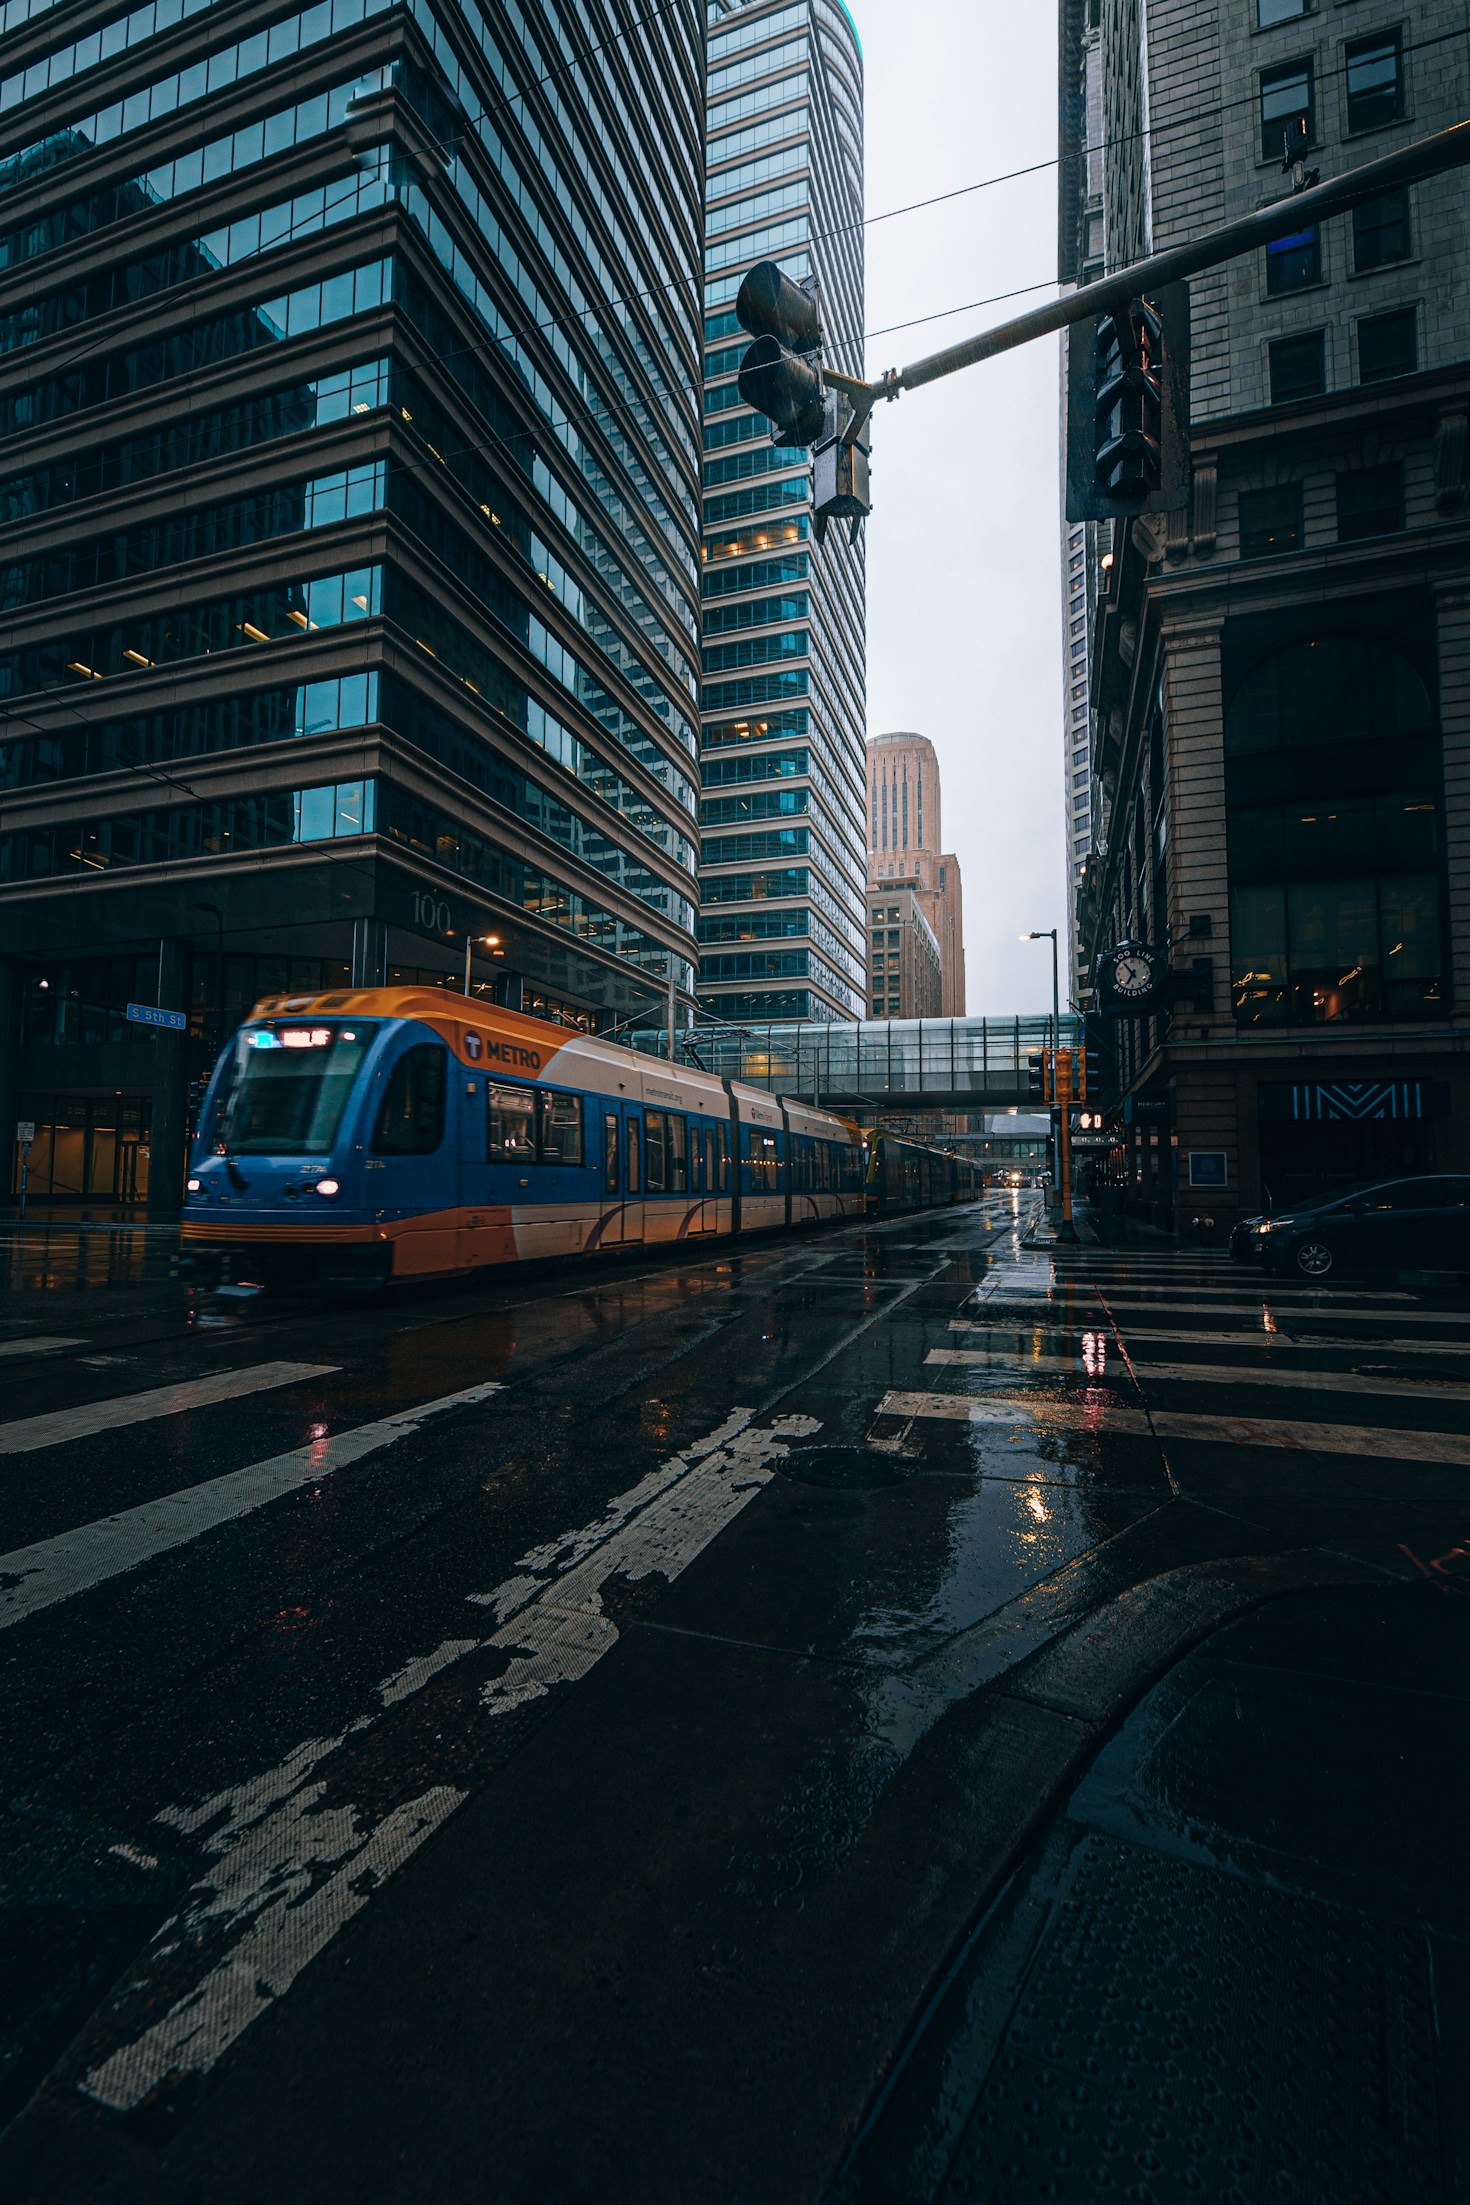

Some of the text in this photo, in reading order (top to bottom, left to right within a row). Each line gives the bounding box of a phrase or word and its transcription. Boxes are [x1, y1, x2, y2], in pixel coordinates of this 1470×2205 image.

[410, 890, 451, 934] 100
[1113, 950, 1155, 964] SOO LINE
[1112, 983, 1153, 997] BUILDING
[132, 1008, 182, 1026] S 5th St
[487, 1039, 541, 1070] METRO
